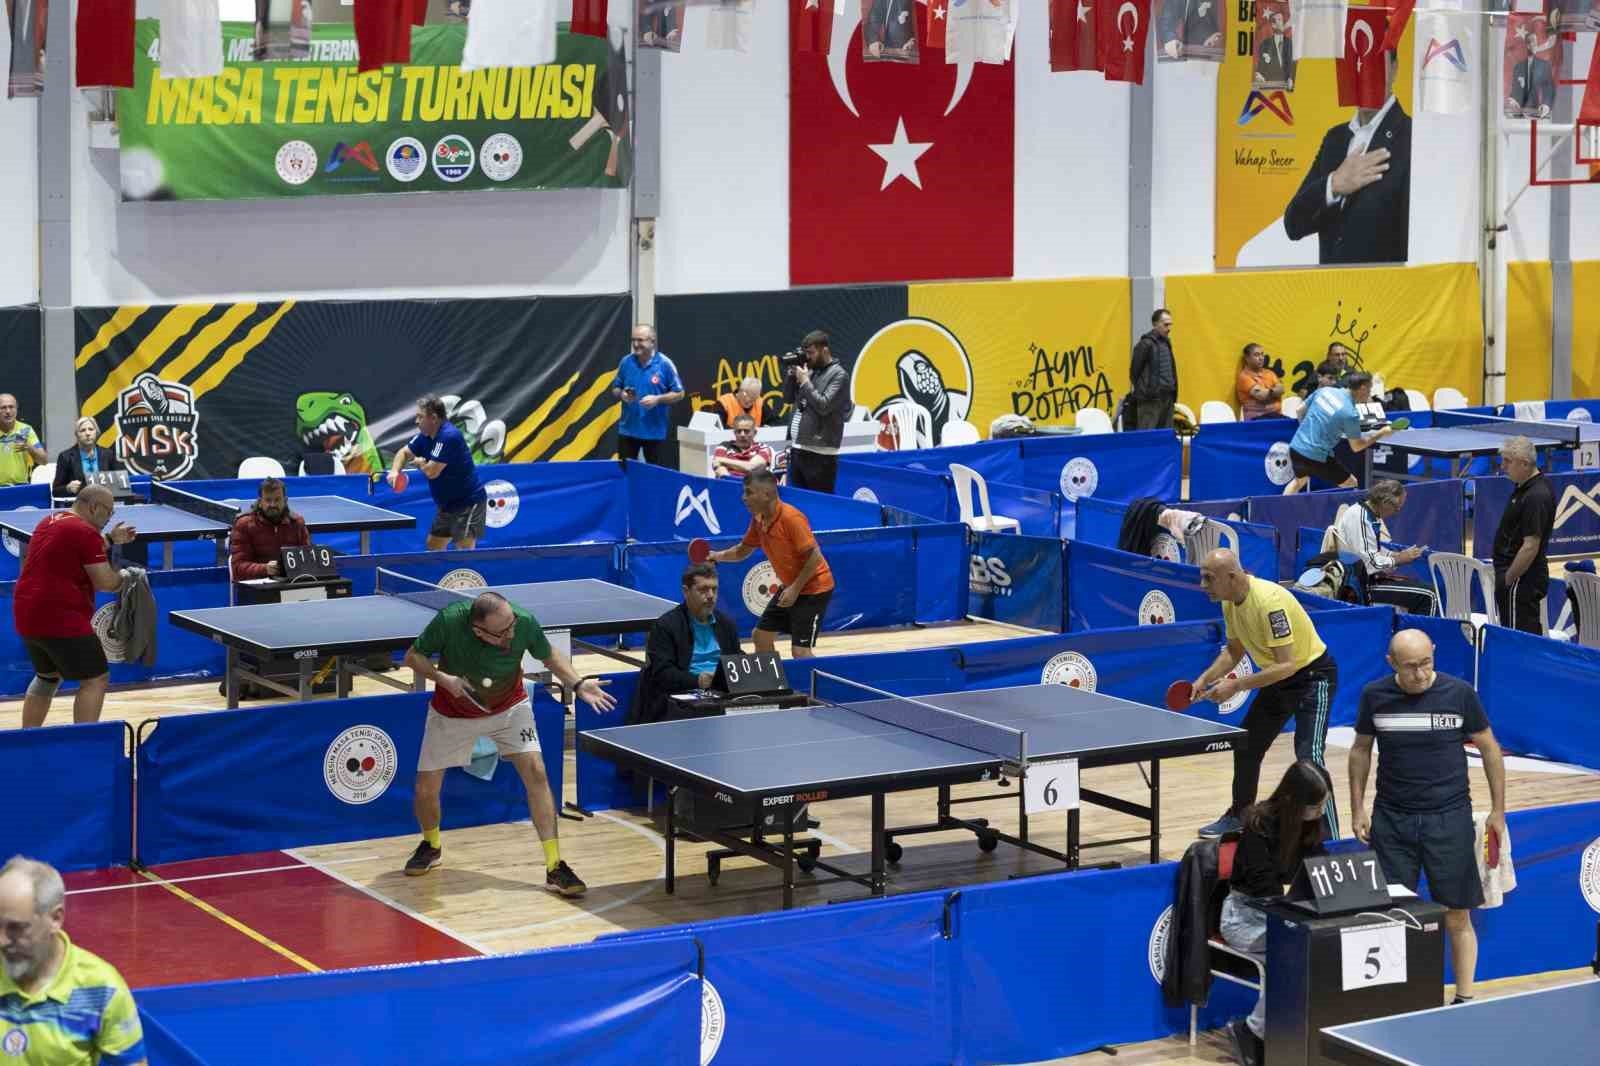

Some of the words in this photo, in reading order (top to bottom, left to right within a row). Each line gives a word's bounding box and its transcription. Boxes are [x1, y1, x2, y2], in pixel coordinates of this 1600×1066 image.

[146, 67, 264, 126] MASA
[401, 63, 597, 122] TURNUVASI
[121, 424, 192, 458] MSK
[1580, 451, 1593, 467] 12
[286, 551, 296, 569] 6
[299, 550, 305, 562] 1
[311, 548, 316, 561] 1
[321, 549, 330, 567] 9
[727, 660, 739, 682] 3
[742, 658, 751, 674] 0
[754, 655, 762, 672] 1
[769, 657, 780, 679] 1
[762, 794, 795, 807] EXPERT
[795, 789, 829, 802] ROLLER
[1043, 777, 1058, 806] 6
[1311, 865, 1334, 896] 11
[1330, 860, 1344, 883] 3
[1346, 858, 1357, 881] 1
[1363, 860, 1378, 890] 7
[1364, 946, 1380, 980] 5
